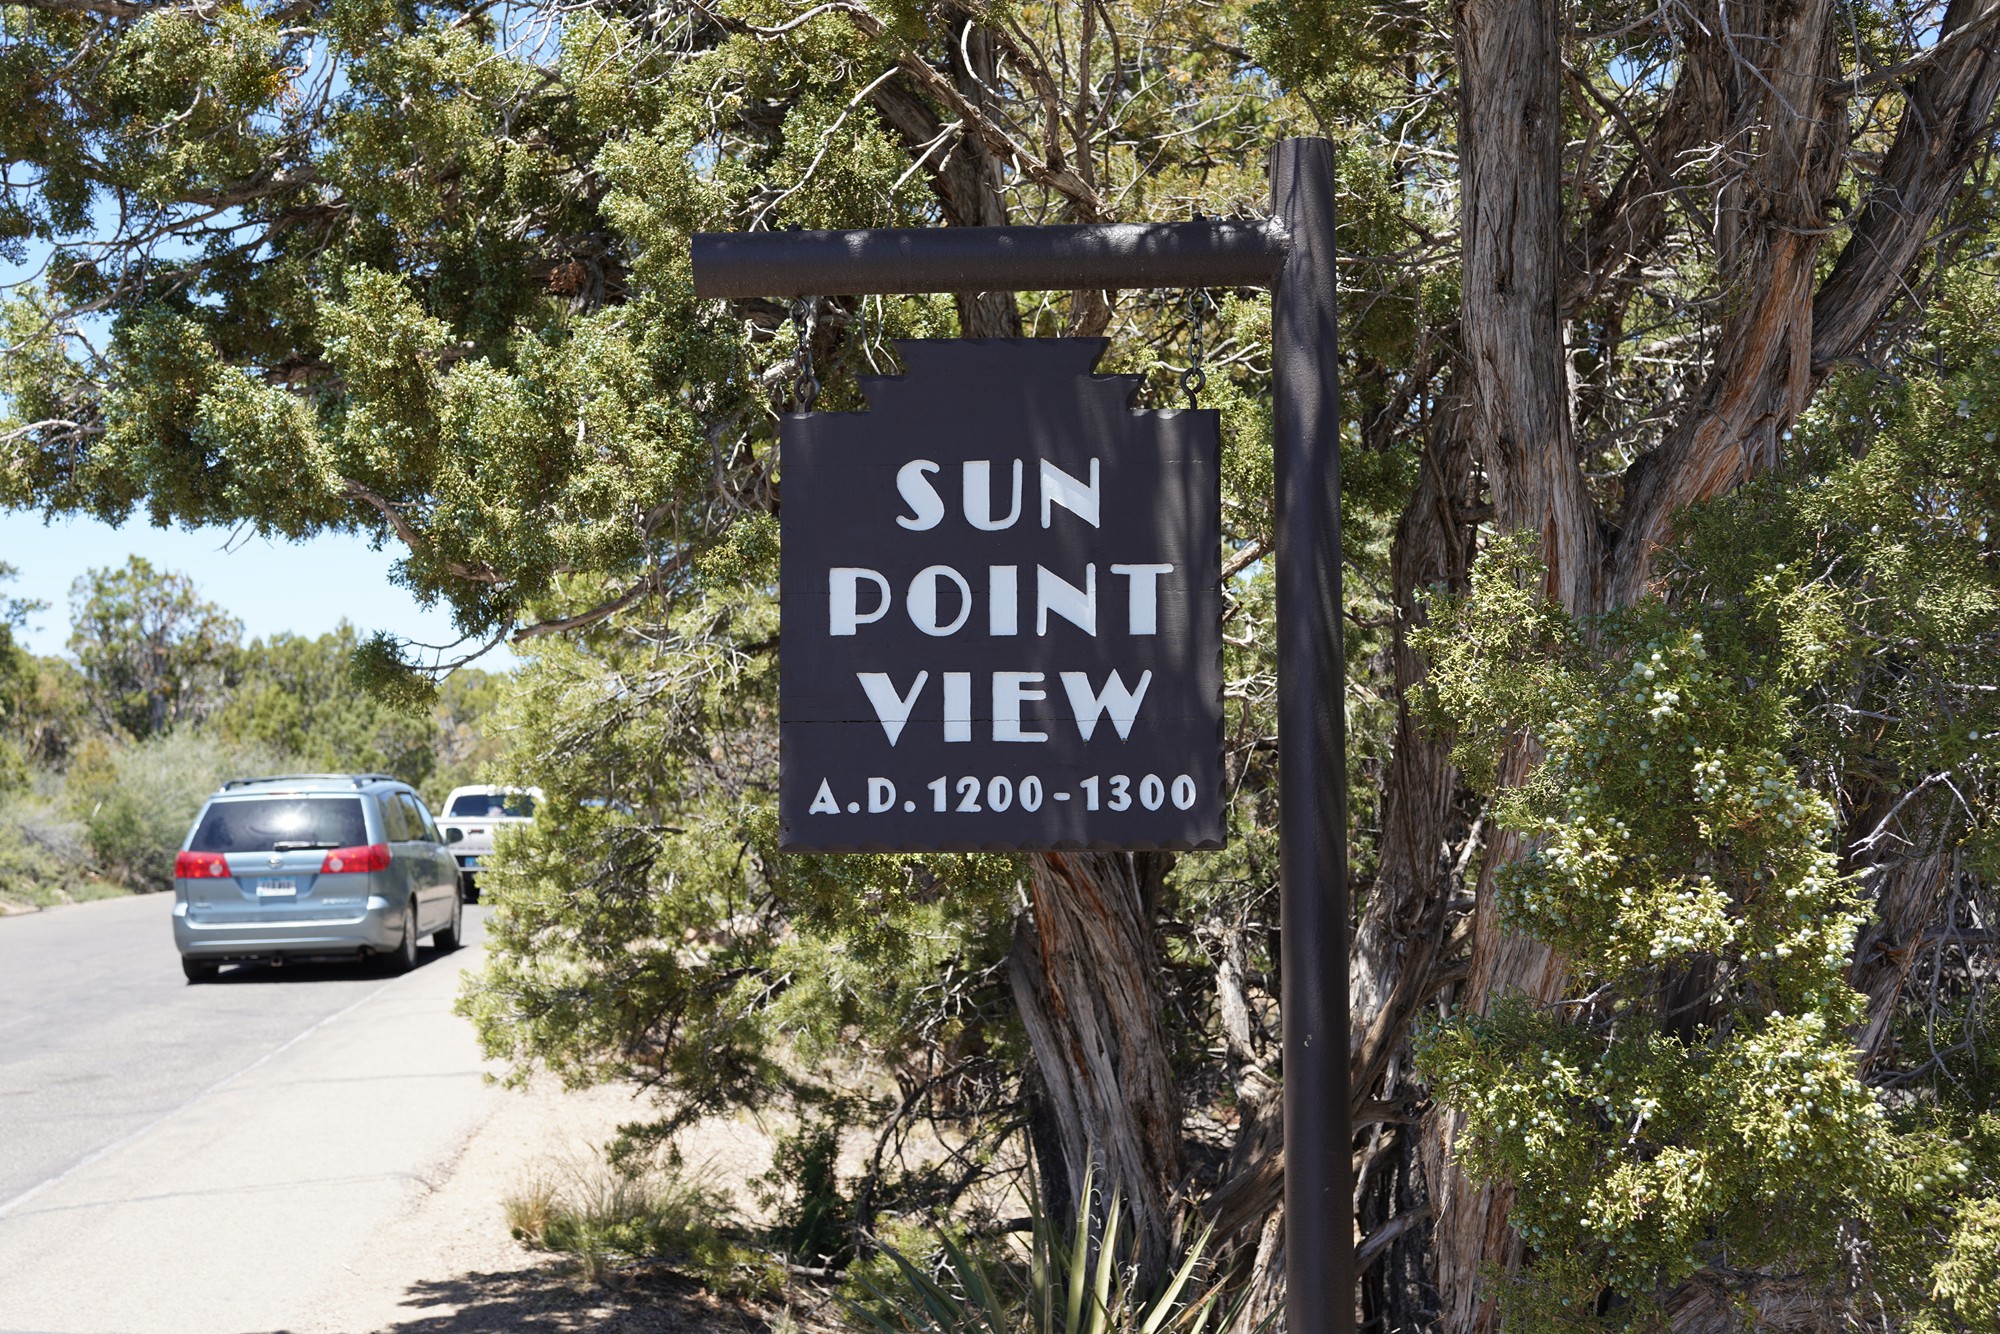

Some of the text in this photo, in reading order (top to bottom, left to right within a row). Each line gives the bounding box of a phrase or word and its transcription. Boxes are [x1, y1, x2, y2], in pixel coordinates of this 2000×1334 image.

[895, 458, 1100, 531] SUN
[828, 563, 1175, 637] POINT
[856, 669, 1153, 747] VIEW
[808, 774, 1198, 815] A.D. 1200-1300
